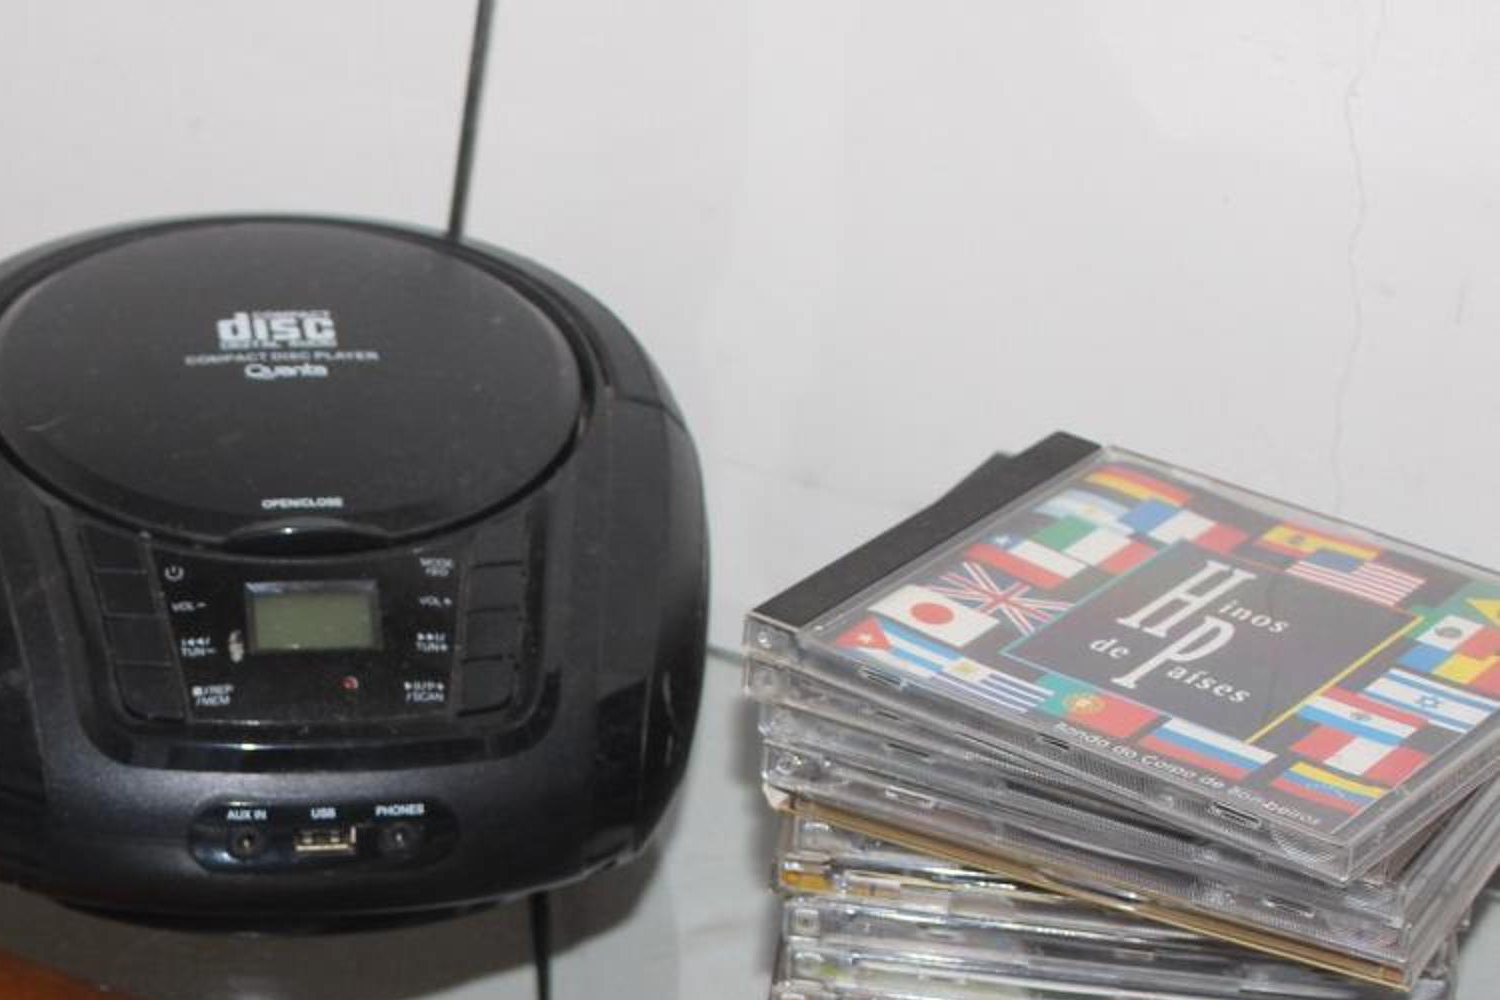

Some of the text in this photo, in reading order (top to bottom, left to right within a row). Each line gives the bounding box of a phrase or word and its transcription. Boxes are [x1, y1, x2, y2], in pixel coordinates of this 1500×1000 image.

[217, 311, 336, 342] disc
[1088, 636, 1130, 660] de
[227, 809, 251, 820] AUX
[310, 807, 337, 819] USB
[375, 803, 425, 816] PHONES
